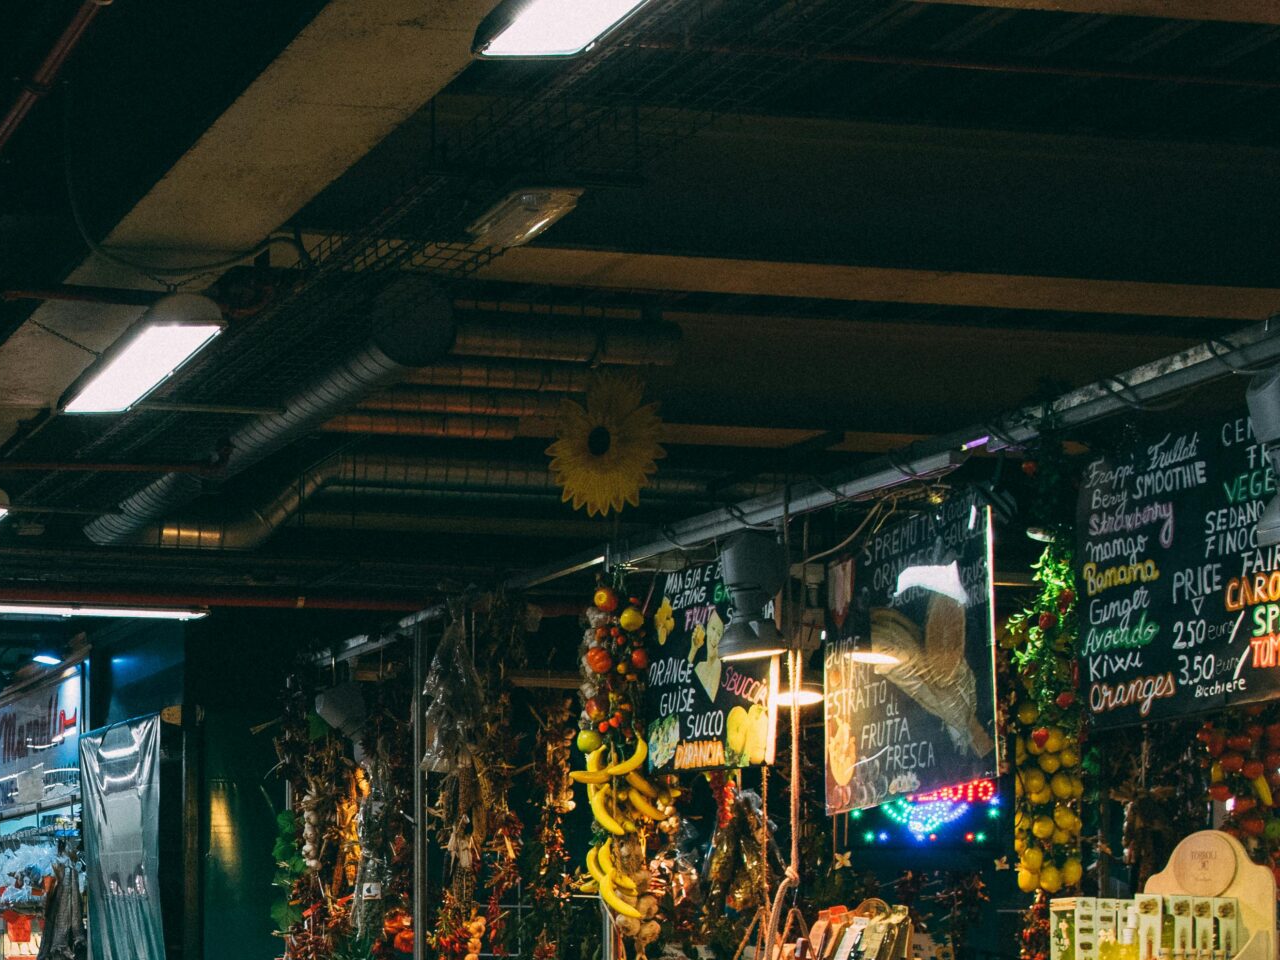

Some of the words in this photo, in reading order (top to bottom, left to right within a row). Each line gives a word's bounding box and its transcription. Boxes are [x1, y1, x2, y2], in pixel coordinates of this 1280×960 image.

[1132, 461, 1207, 499] SMOOTHIE
[1091, 488, 1128, 516] Berry
[1088, 501, 1174, 548] Strawberry
[1083, 559, 1160, 596] Banana
[1173, 563, 1222, 604] PRICE
[672, 586, 707, 611] EATING
[1089, 586, 1150, 630] Ginger
[1082, 610, 1160, 656] Avocado
[649, 657, 694, 688] ORANGE
[1089, 645, 1144, 682] Kiwi
[1178, 653, 1216, 685] 3.50
[686, 709, 724, 740] SUCCO
[861, 717, 911, 750] FRUTTA
[886, 741, 936, 771] FRESCA
